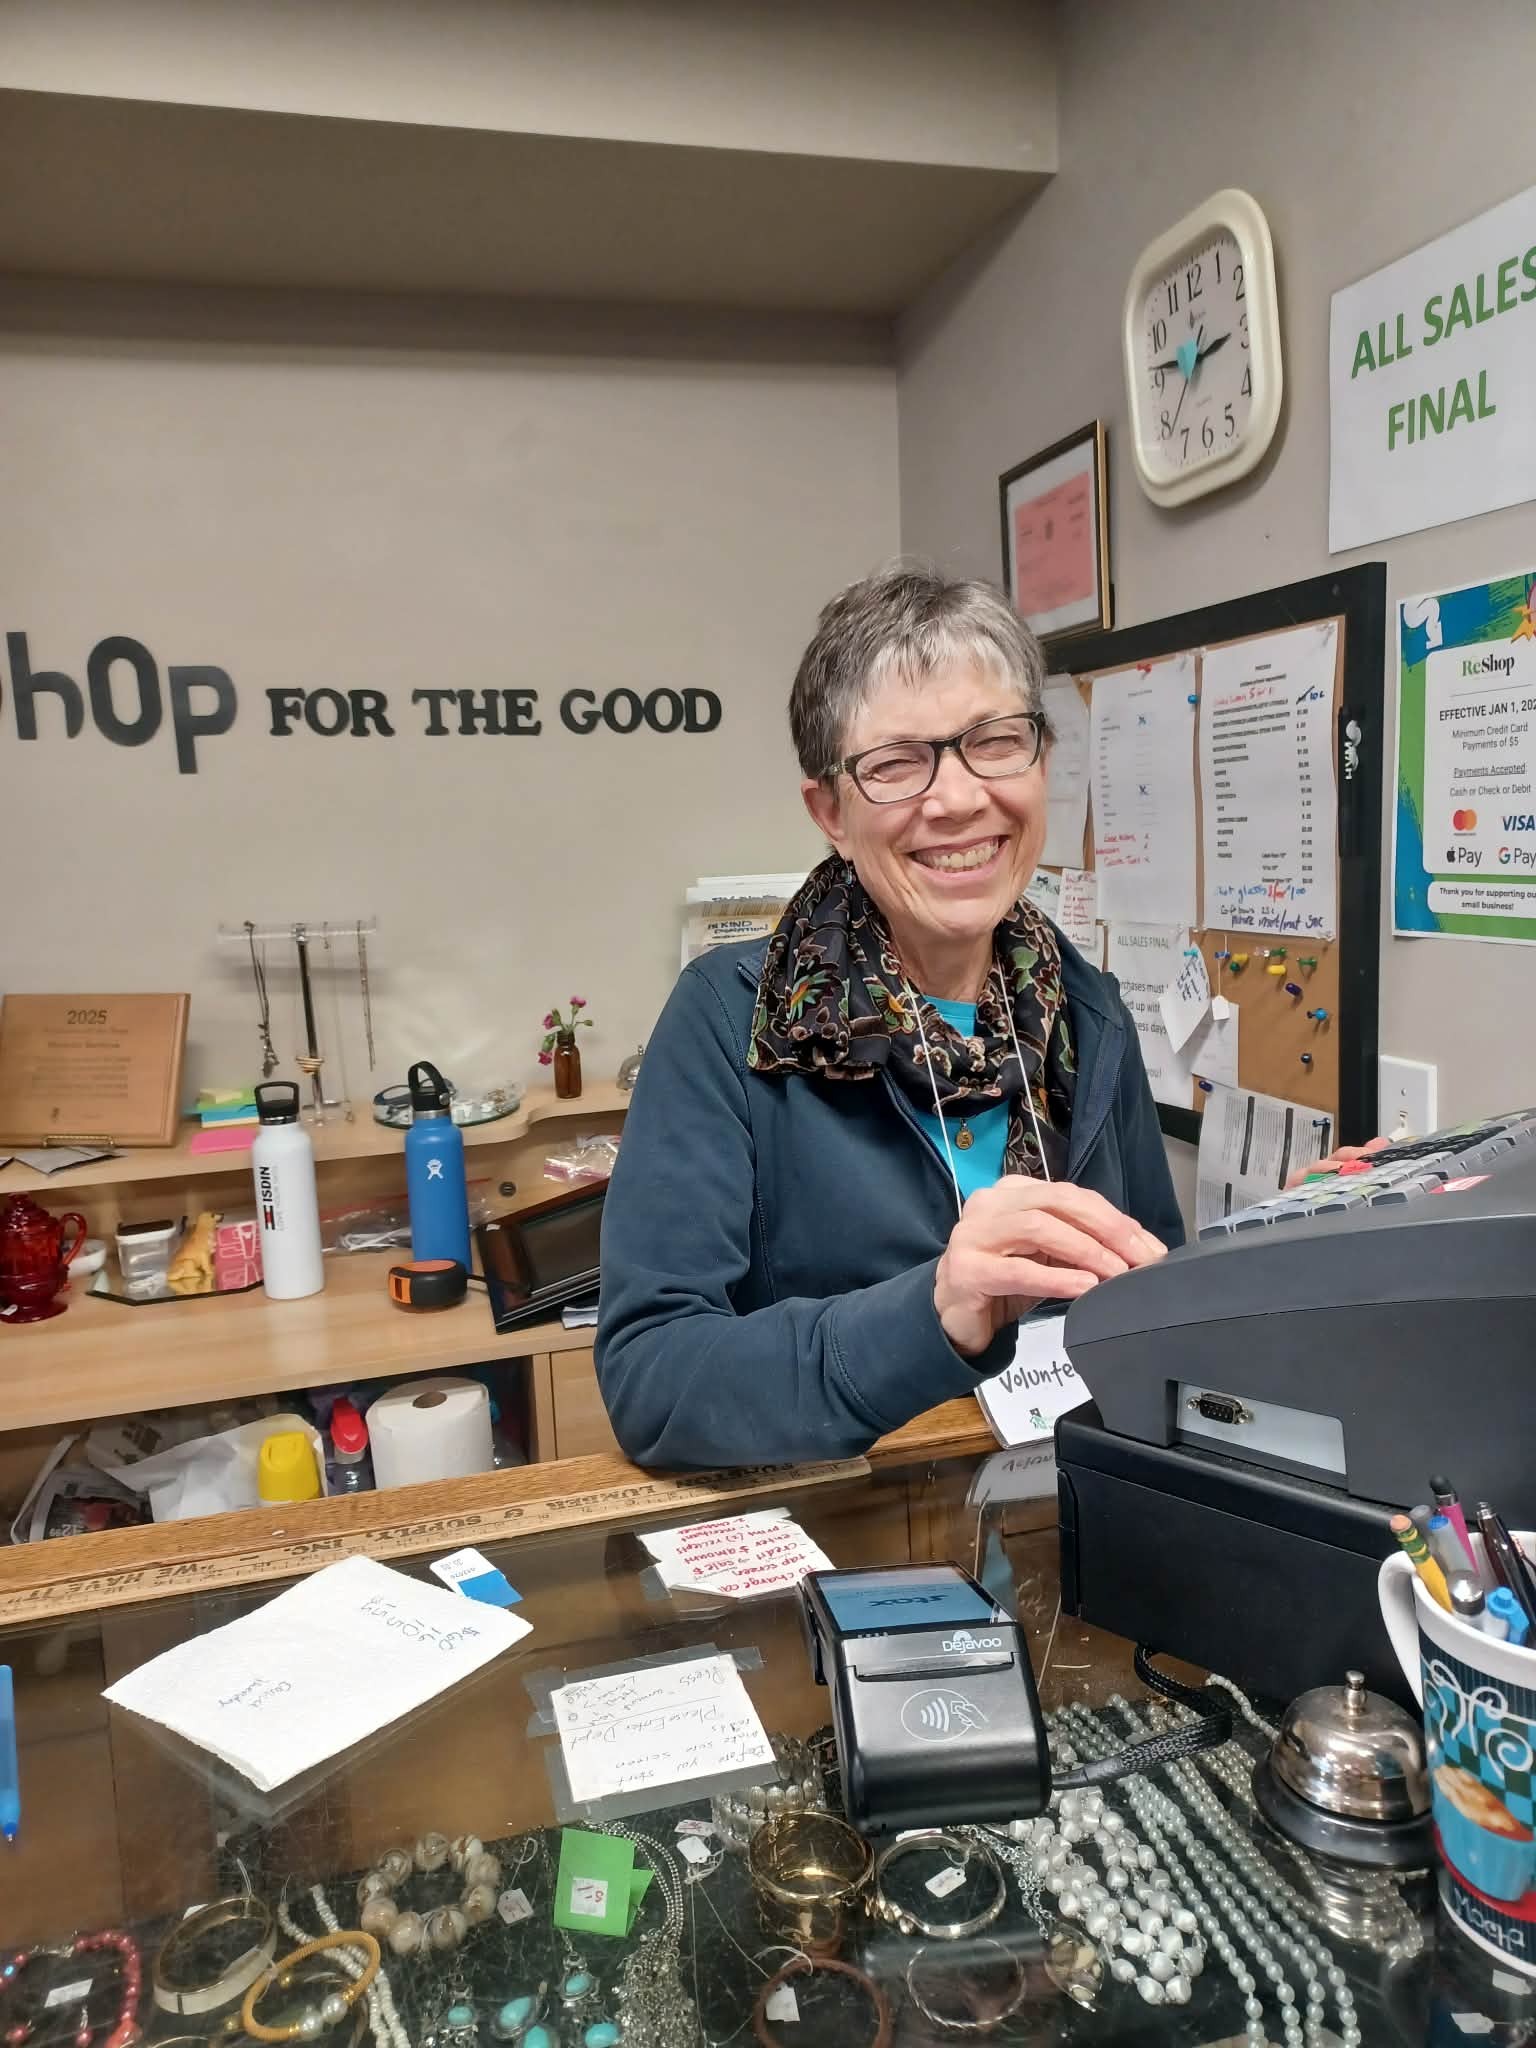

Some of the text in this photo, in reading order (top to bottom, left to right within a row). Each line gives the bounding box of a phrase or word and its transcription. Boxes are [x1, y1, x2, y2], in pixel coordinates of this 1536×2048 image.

[1215, 251, 1222, 284] 1
[1187, 263, 1203, 303] 12
[1233, 264, 1245, 301] 2
[1167, 281, 1179, 317] 11
[1351, 245, 1536, 380] ALL SALES
[1152, 319, 1167, 354] 10
[1239, 314, 1250, 349] 3
[1241, 363, 1252, 397] 4
[1224, 403, 1235, 438] 5
[1387, 370, 1496, 452] FINAL
[1160, 410, 1172, 440] 8
[1201, 416, 1214, 449] 6
[1180, 427, 1190, 459] 7
[1462, 654, 1515, 676] ReShop
[0, 631, 722, 774] hOp FOR THE GOOD
[1440, 705, 1486, 721] EFFECTIVE
[1489, 702, 1508, 716] JAN
[1511, 701, 1519, 714] 1,
[1452, 722, 1528, 738] Minimum Credit Card
[1463, 736, 1519, 751] Payments of $5
[1454, 763, 1526, 778] Payments Accepted
[1450, 787, 1468, 797] Cash
[1469, 788, 1476, 796] or
[1479, 785, 1501, 795] Check
[1512, 783, 1531, 794] Debit
[1502, 815, 1536, 831] VISA
[1458, 847, 1482, 867] Pay
[1514, 848, 1536, 868] Pay
[1440, 887, 1459, 895] Thank
[1475, 888, 1485, 896] for
[1486, 889, 1525, 899] supporting
[1481, 901, 1514, 910] business!
[720, 920, 753, 928] KIND
[1131, 936, 1148, 948] SALES
[1149, 937, 1169, 949] FINAL
[1147, 983, 1164, 994] must
[1136, 1001, 1145, 1012] up
[67, 1009, 108, 1025] 2025
[259, 1166, 273, 1202] ISDIN
[546, 1485, 656, 1511] LUMBER
[283, 1539, 344, 1556] INC.
[755, 1533, 791, 1547] enter
[684, 1548, 736, 1565] amount
[757, 1542, 797, 1561] credit
[782, 1553, 806, 1566] tap
[704, 1558, 735, 1572] sale
[732, 1562, 778, 1577] screen
[67, 1571, 144, 1594] HAVE
[744, 1572, 795, 1590] charge
[941, 1637, 1002, 1654] Dejavoo
[668, 1703, 719, 1722] Please
[719, 1743, 766, 1762] Before
[676, 1758, 699, 1772] you
